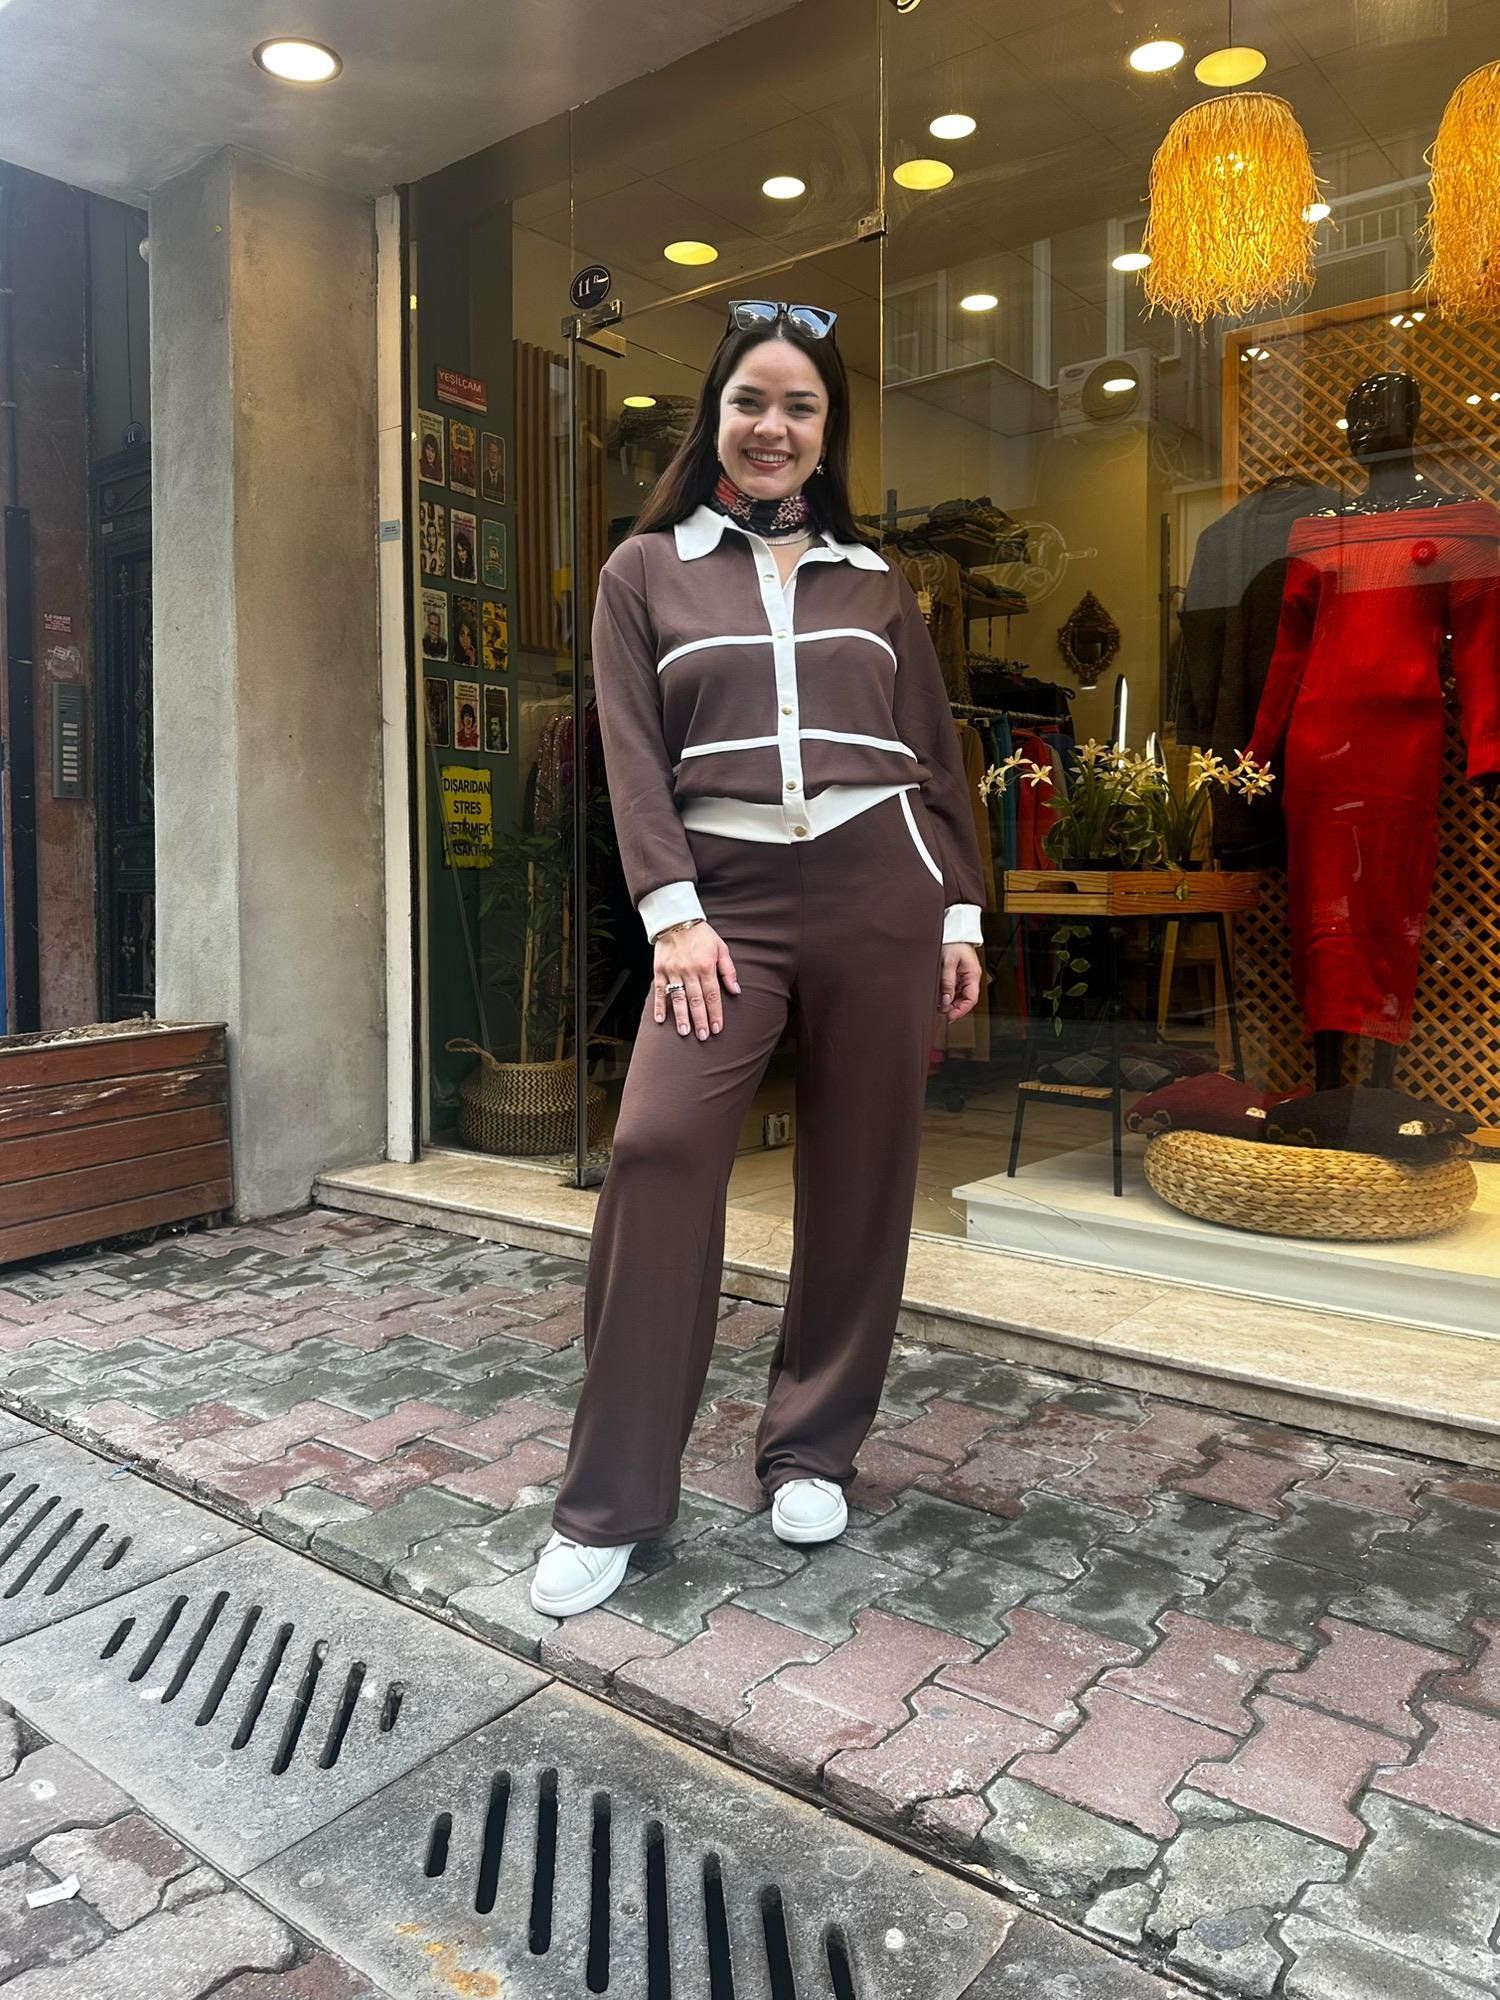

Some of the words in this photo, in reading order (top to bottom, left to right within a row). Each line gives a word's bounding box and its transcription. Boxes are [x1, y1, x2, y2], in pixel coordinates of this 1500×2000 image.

[439, 371, 482, 393] YEŞİLÇAM
[443, 777, 491, 795] DIŞARIDAN
[453, 800, 482, 815] STRES
